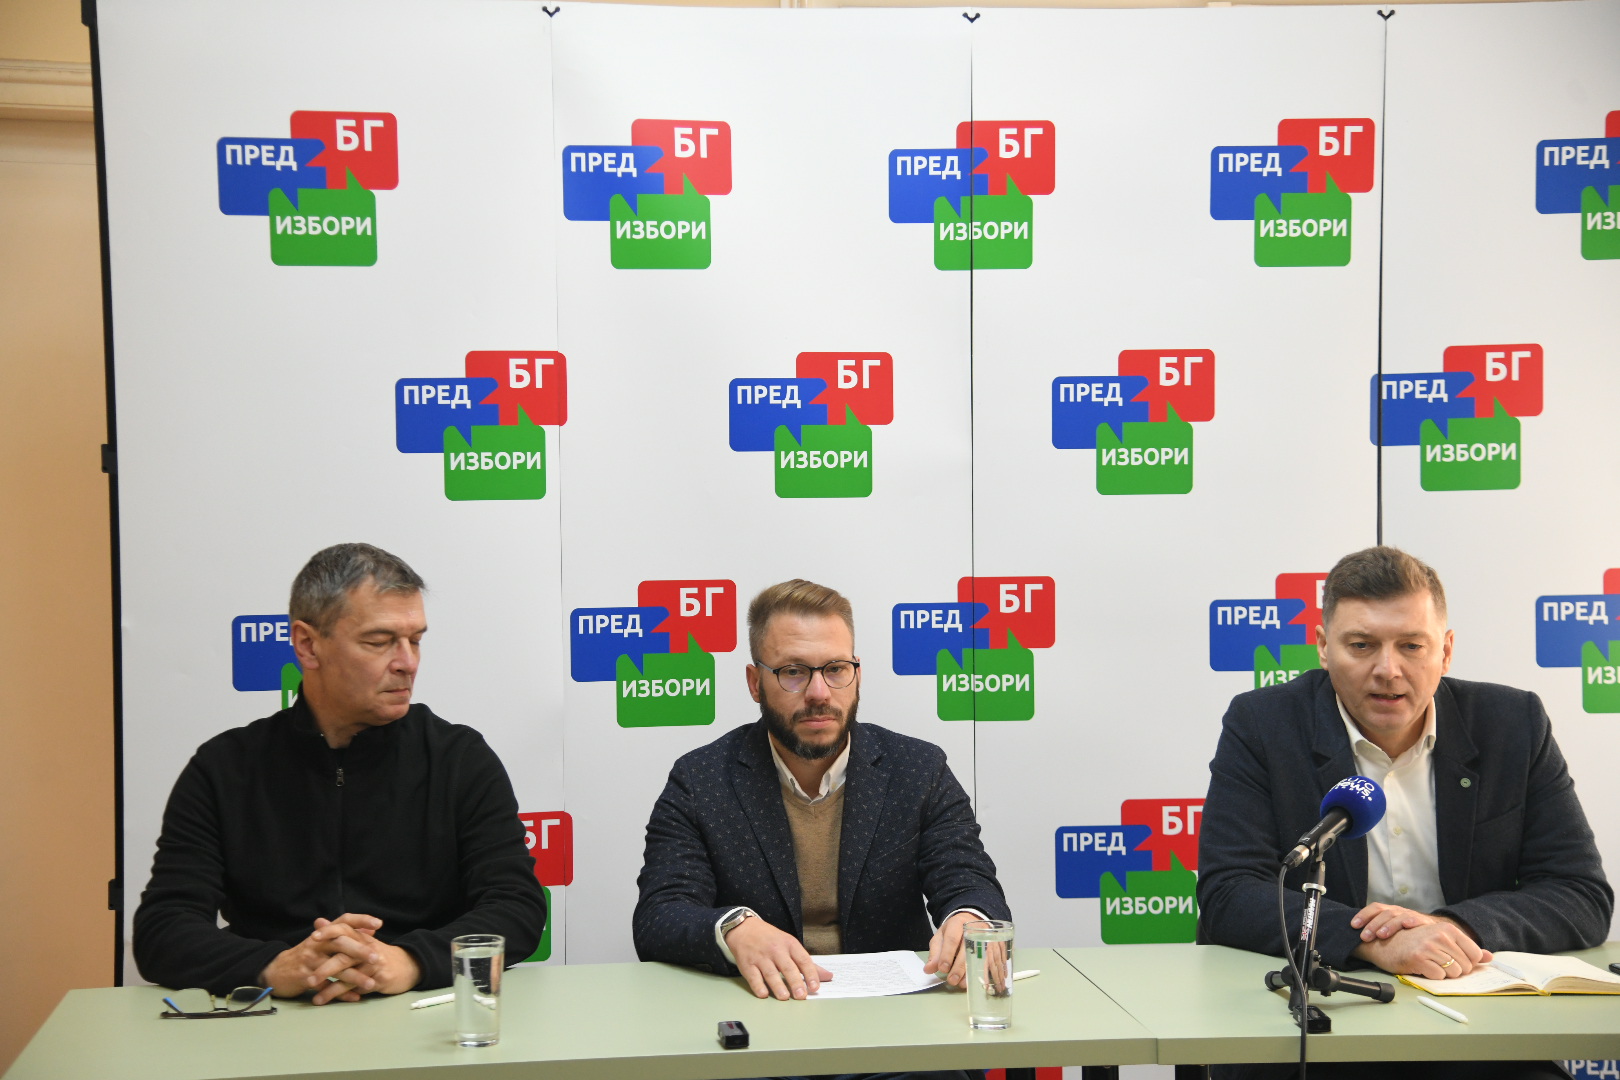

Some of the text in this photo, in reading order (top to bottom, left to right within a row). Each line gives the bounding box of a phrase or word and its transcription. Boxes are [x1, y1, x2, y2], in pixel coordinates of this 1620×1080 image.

[335, 118, 384, 152] БГ
[673, 127, 719, 158] БГ
[998, 127, 1044, 159] БГ
[1318, 125, 1364, 157] БГ
[225, 144, 298, 171] ПРЕД
[570, 152, 638, 178] ПРЕД
[896, 155, 962, 180] ПРЕД
[1218, 152, 1283, 177] ПРЕД
[1543, 144, 1610, 170] ПРЕД
[275, 215, 372, 236] ИЗБОРИ
[616, 220, 707, 240] ИЗБОРИ
[939, 221, 1029, 241] ИЗБОРИ
[1259, 218, 1347, 238] ИЗБОРИ
[1586, 211, 1620, 231] ИЗ
[508, 358, 555, 389] БГ
[837, 359, 881, 389] БГ
[1159, 356, 1204, 387] БГ
[1485, 350, 1532, 382] БГ
[403, 384, 472, 410] ПРЕД
[737, 384, 802, 409] ПРЕД
[1059, 382, 1123, 407] ПРЕД
[1380, 379, 1449, 404] ПРЕД
[449, 451, 542, 471] ИЗБОРИ
[780, 450, 868, 469] ИЗБОРИ
[1101, 447, 1189, 466] ИЗБОРИ
[1426, 442, 1517, 463] ИЗБОРИ
[679, 586, 724, 617] БГ
[999, 583, 1044, 614] БГ
[900, 609, 963, 633] ПРЕД
[1217, 605, 1281, 630] ПРЕД
[1542, 600, 1609, 625] ПРЕД
[240, 621, 293, 646] ПРЕ
[578, 614, 643, 638] ПРЕД
[942, 673, 1030, 693] ИЗБОРИ
[1587, 665, 1620, 685] ИЗ
[622, 678, 711, 698] ИЗБОРИ
[1162, 805, 1203, 836] БГ
[1062, 831, 1127, 856] ПРЕД
[1106, 895, 1193, 916] ИЗБОРИ
